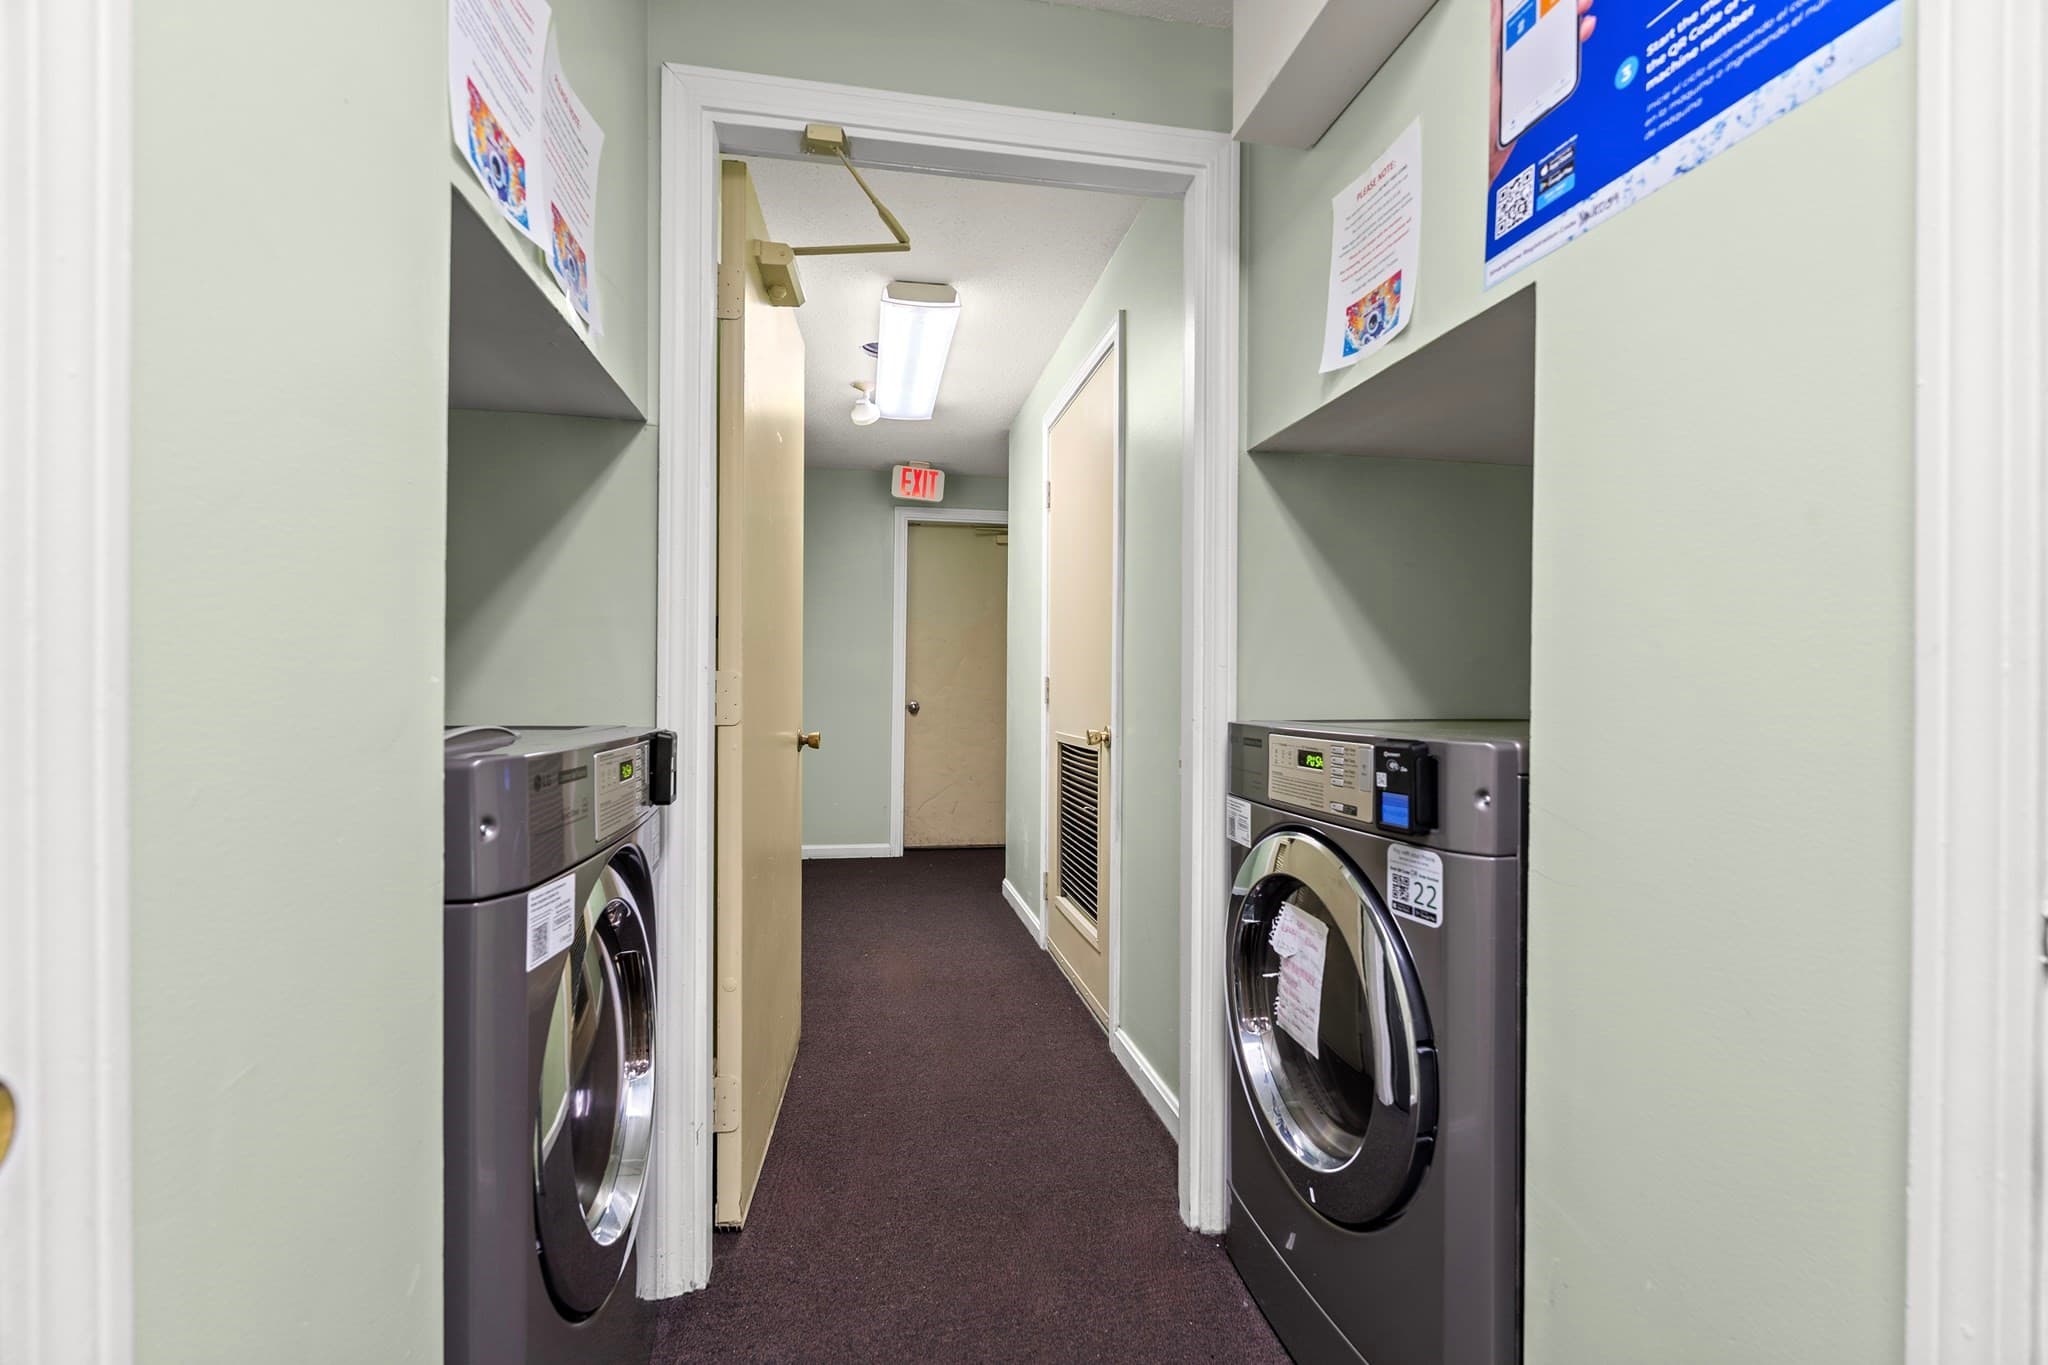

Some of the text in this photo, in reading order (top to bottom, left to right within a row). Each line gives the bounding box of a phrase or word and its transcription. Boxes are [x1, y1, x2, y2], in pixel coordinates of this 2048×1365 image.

[1677, 11, 1699, 33] the
[1646, 54, 1666, 74] the
[1667, 36, 1687, 57] QR
[1689, 11, 1723, 41] Code
[1646, 4, 1755, 91] machine number
[1356, 177, 1377, 202] PLEASE
[901, 467, 939, 499] EXIT
[1414, 881, 1437, 910] 22
